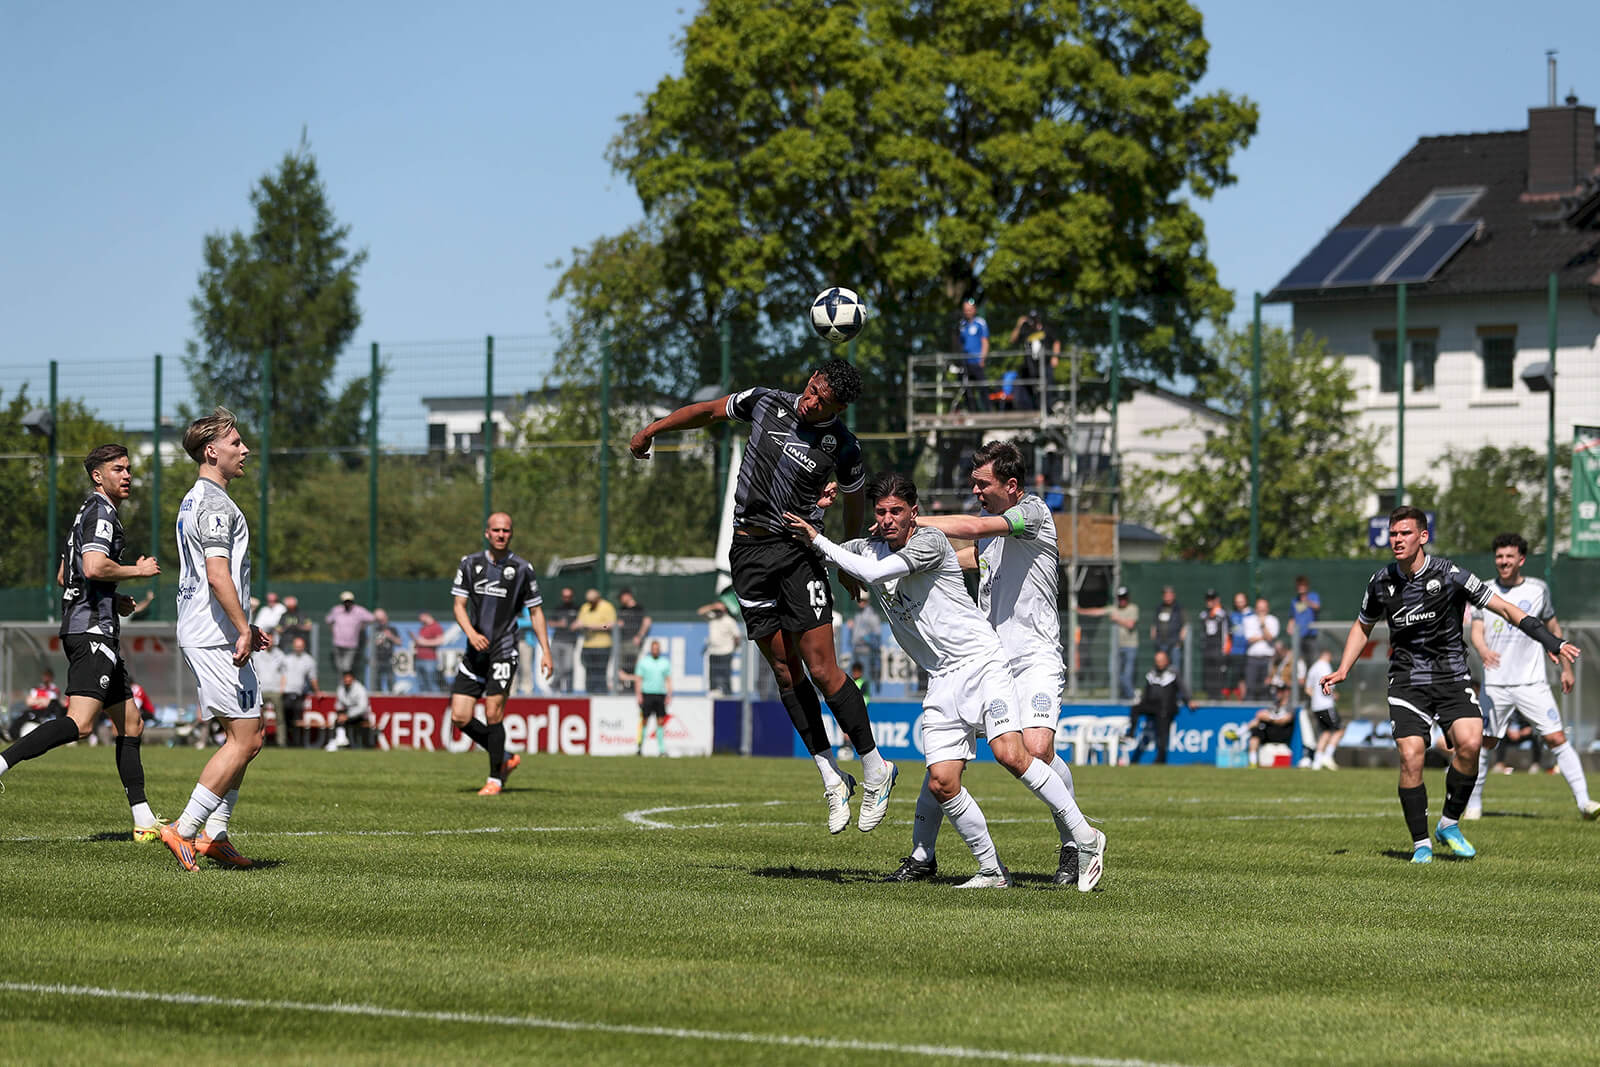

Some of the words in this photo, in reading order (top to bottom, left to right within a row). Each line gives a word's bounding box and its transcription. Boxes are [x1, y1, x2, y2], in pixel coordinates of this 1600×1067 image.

[788, 446, 817, 470] INWO
[806, 580, 828, 607] 13
[1409, 611, 1436, 622] INWO
[492, 662, 511, 680] 20
[239, 689, 255, 709] 11
[994, 718, 1010, 727] JAKO
